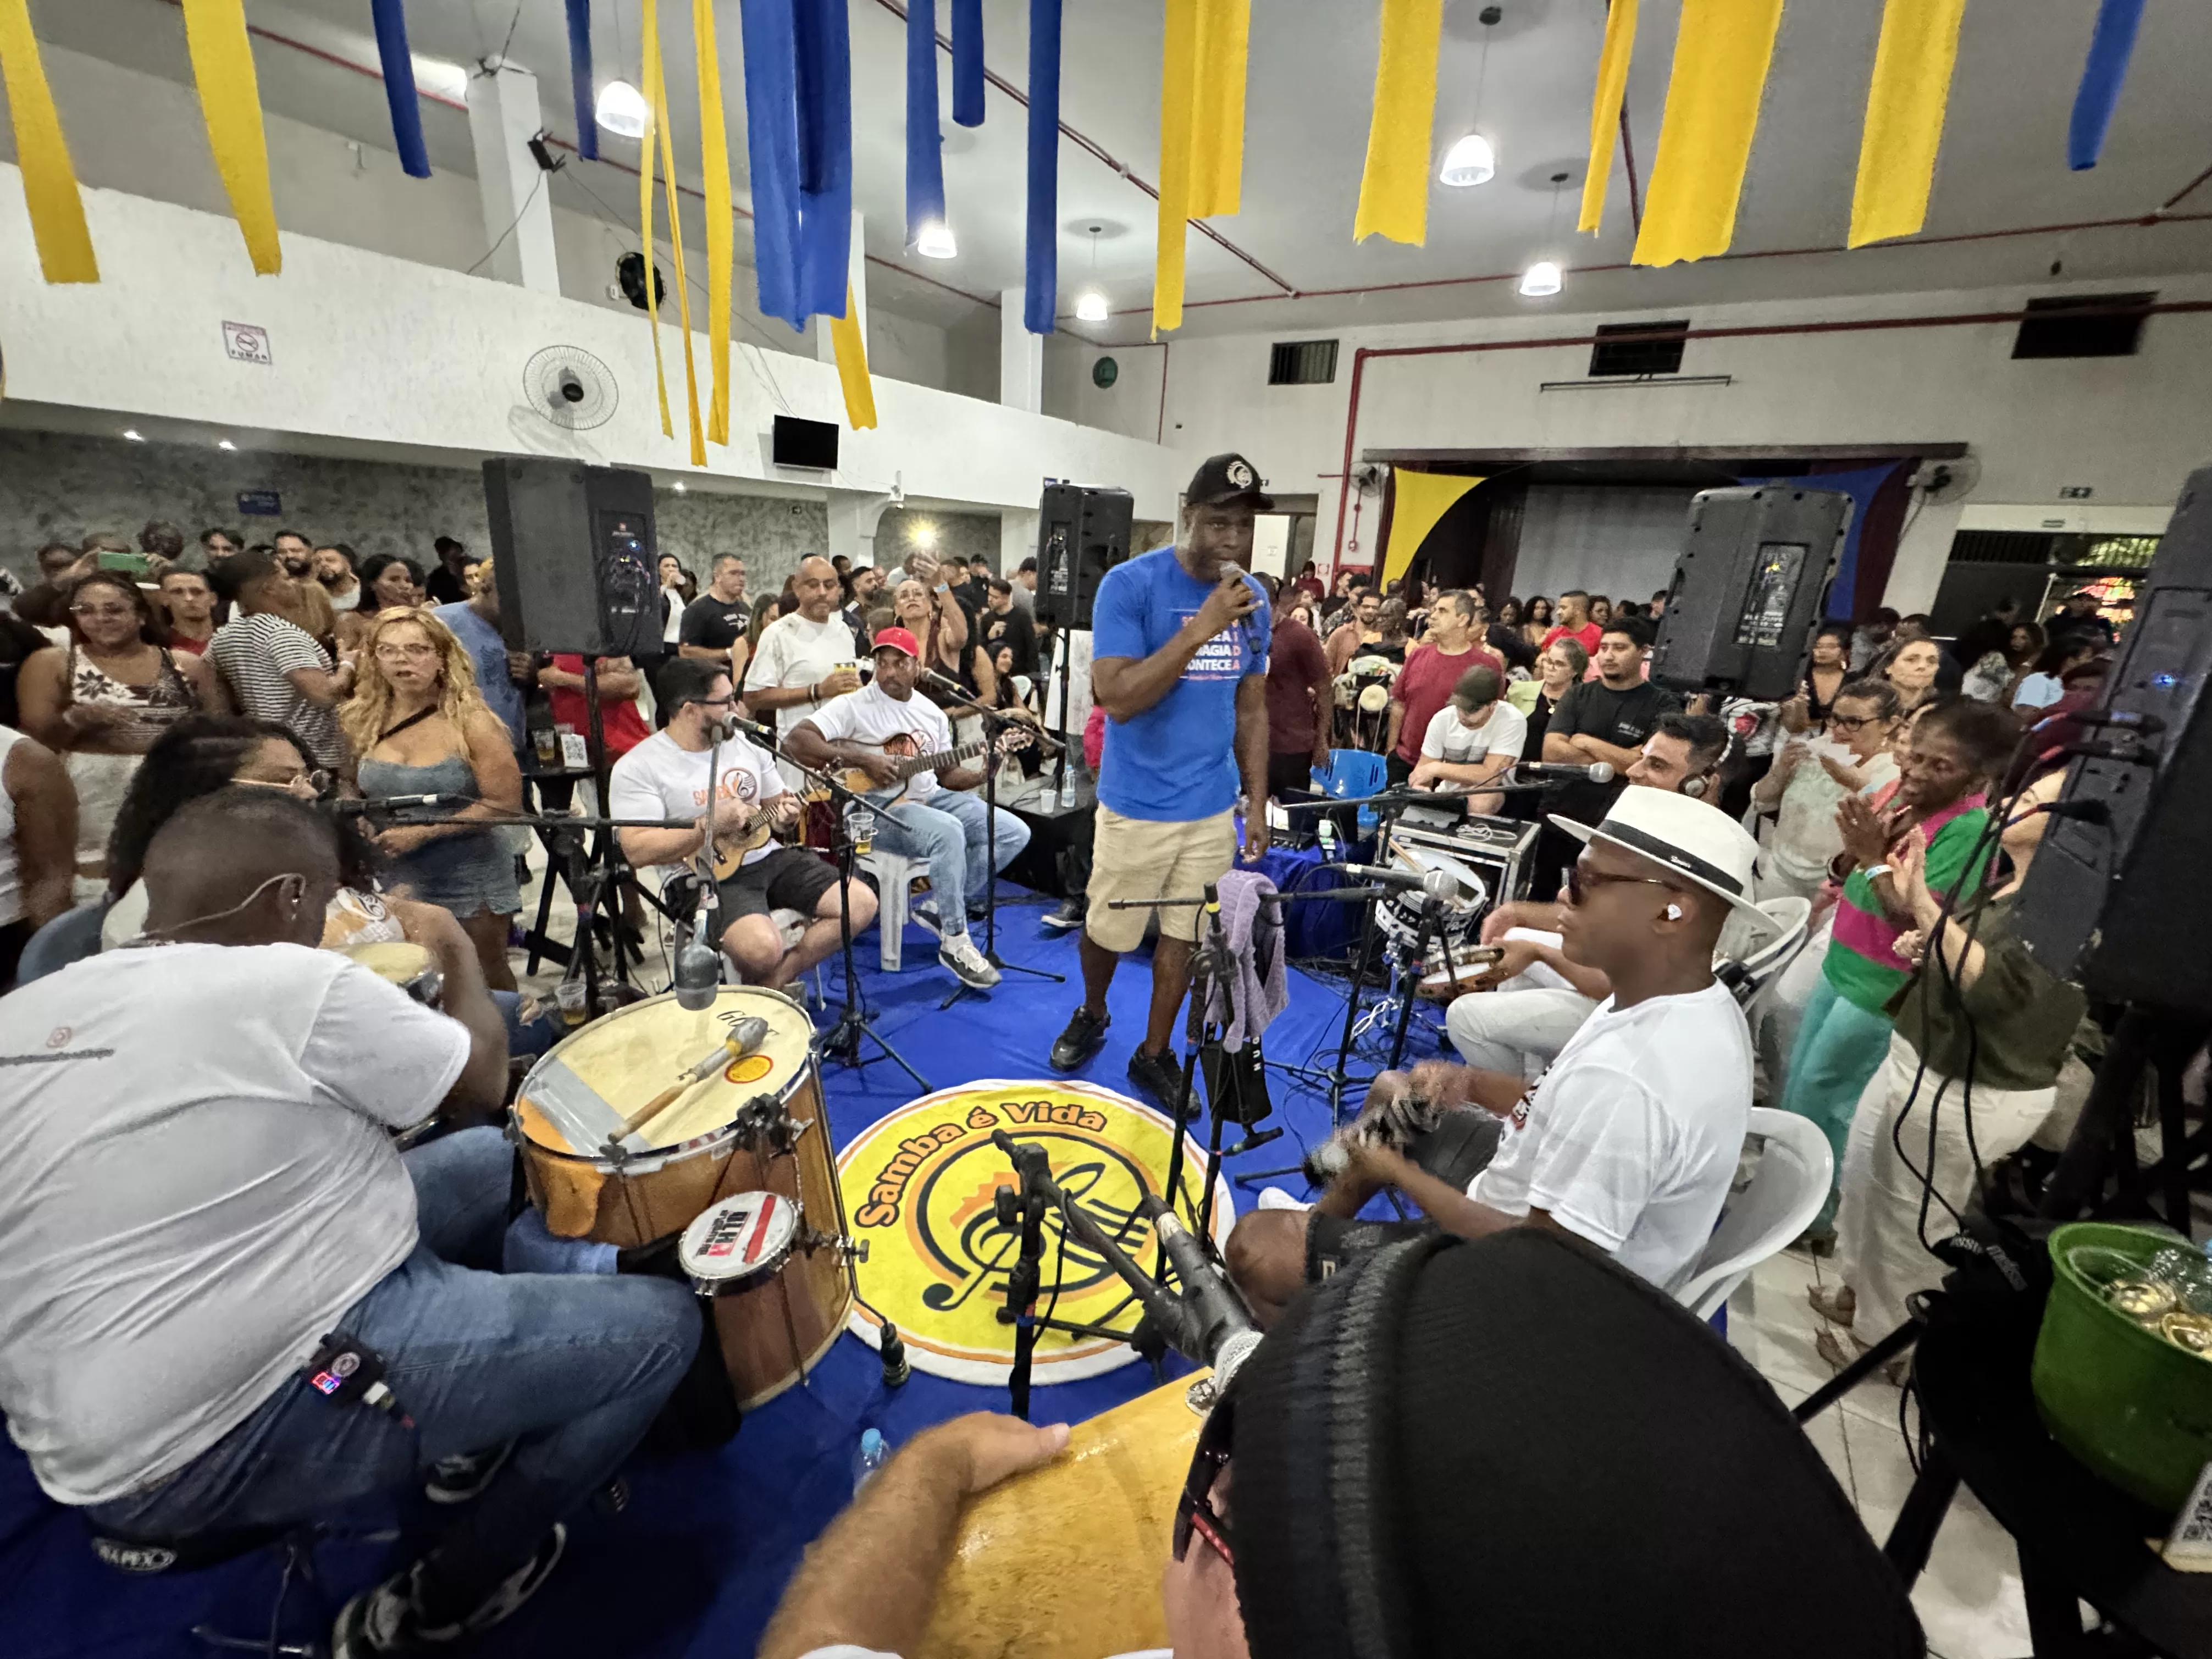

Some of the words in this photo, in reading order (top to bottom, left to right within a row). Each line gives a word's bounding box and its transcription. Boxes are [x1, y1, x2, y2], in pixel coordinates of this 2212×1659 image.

[854, 1123, 967, 1227] Samba
[966, 1106, 999, 1129] é
[999, 1101, 1107, 1132] Vida
